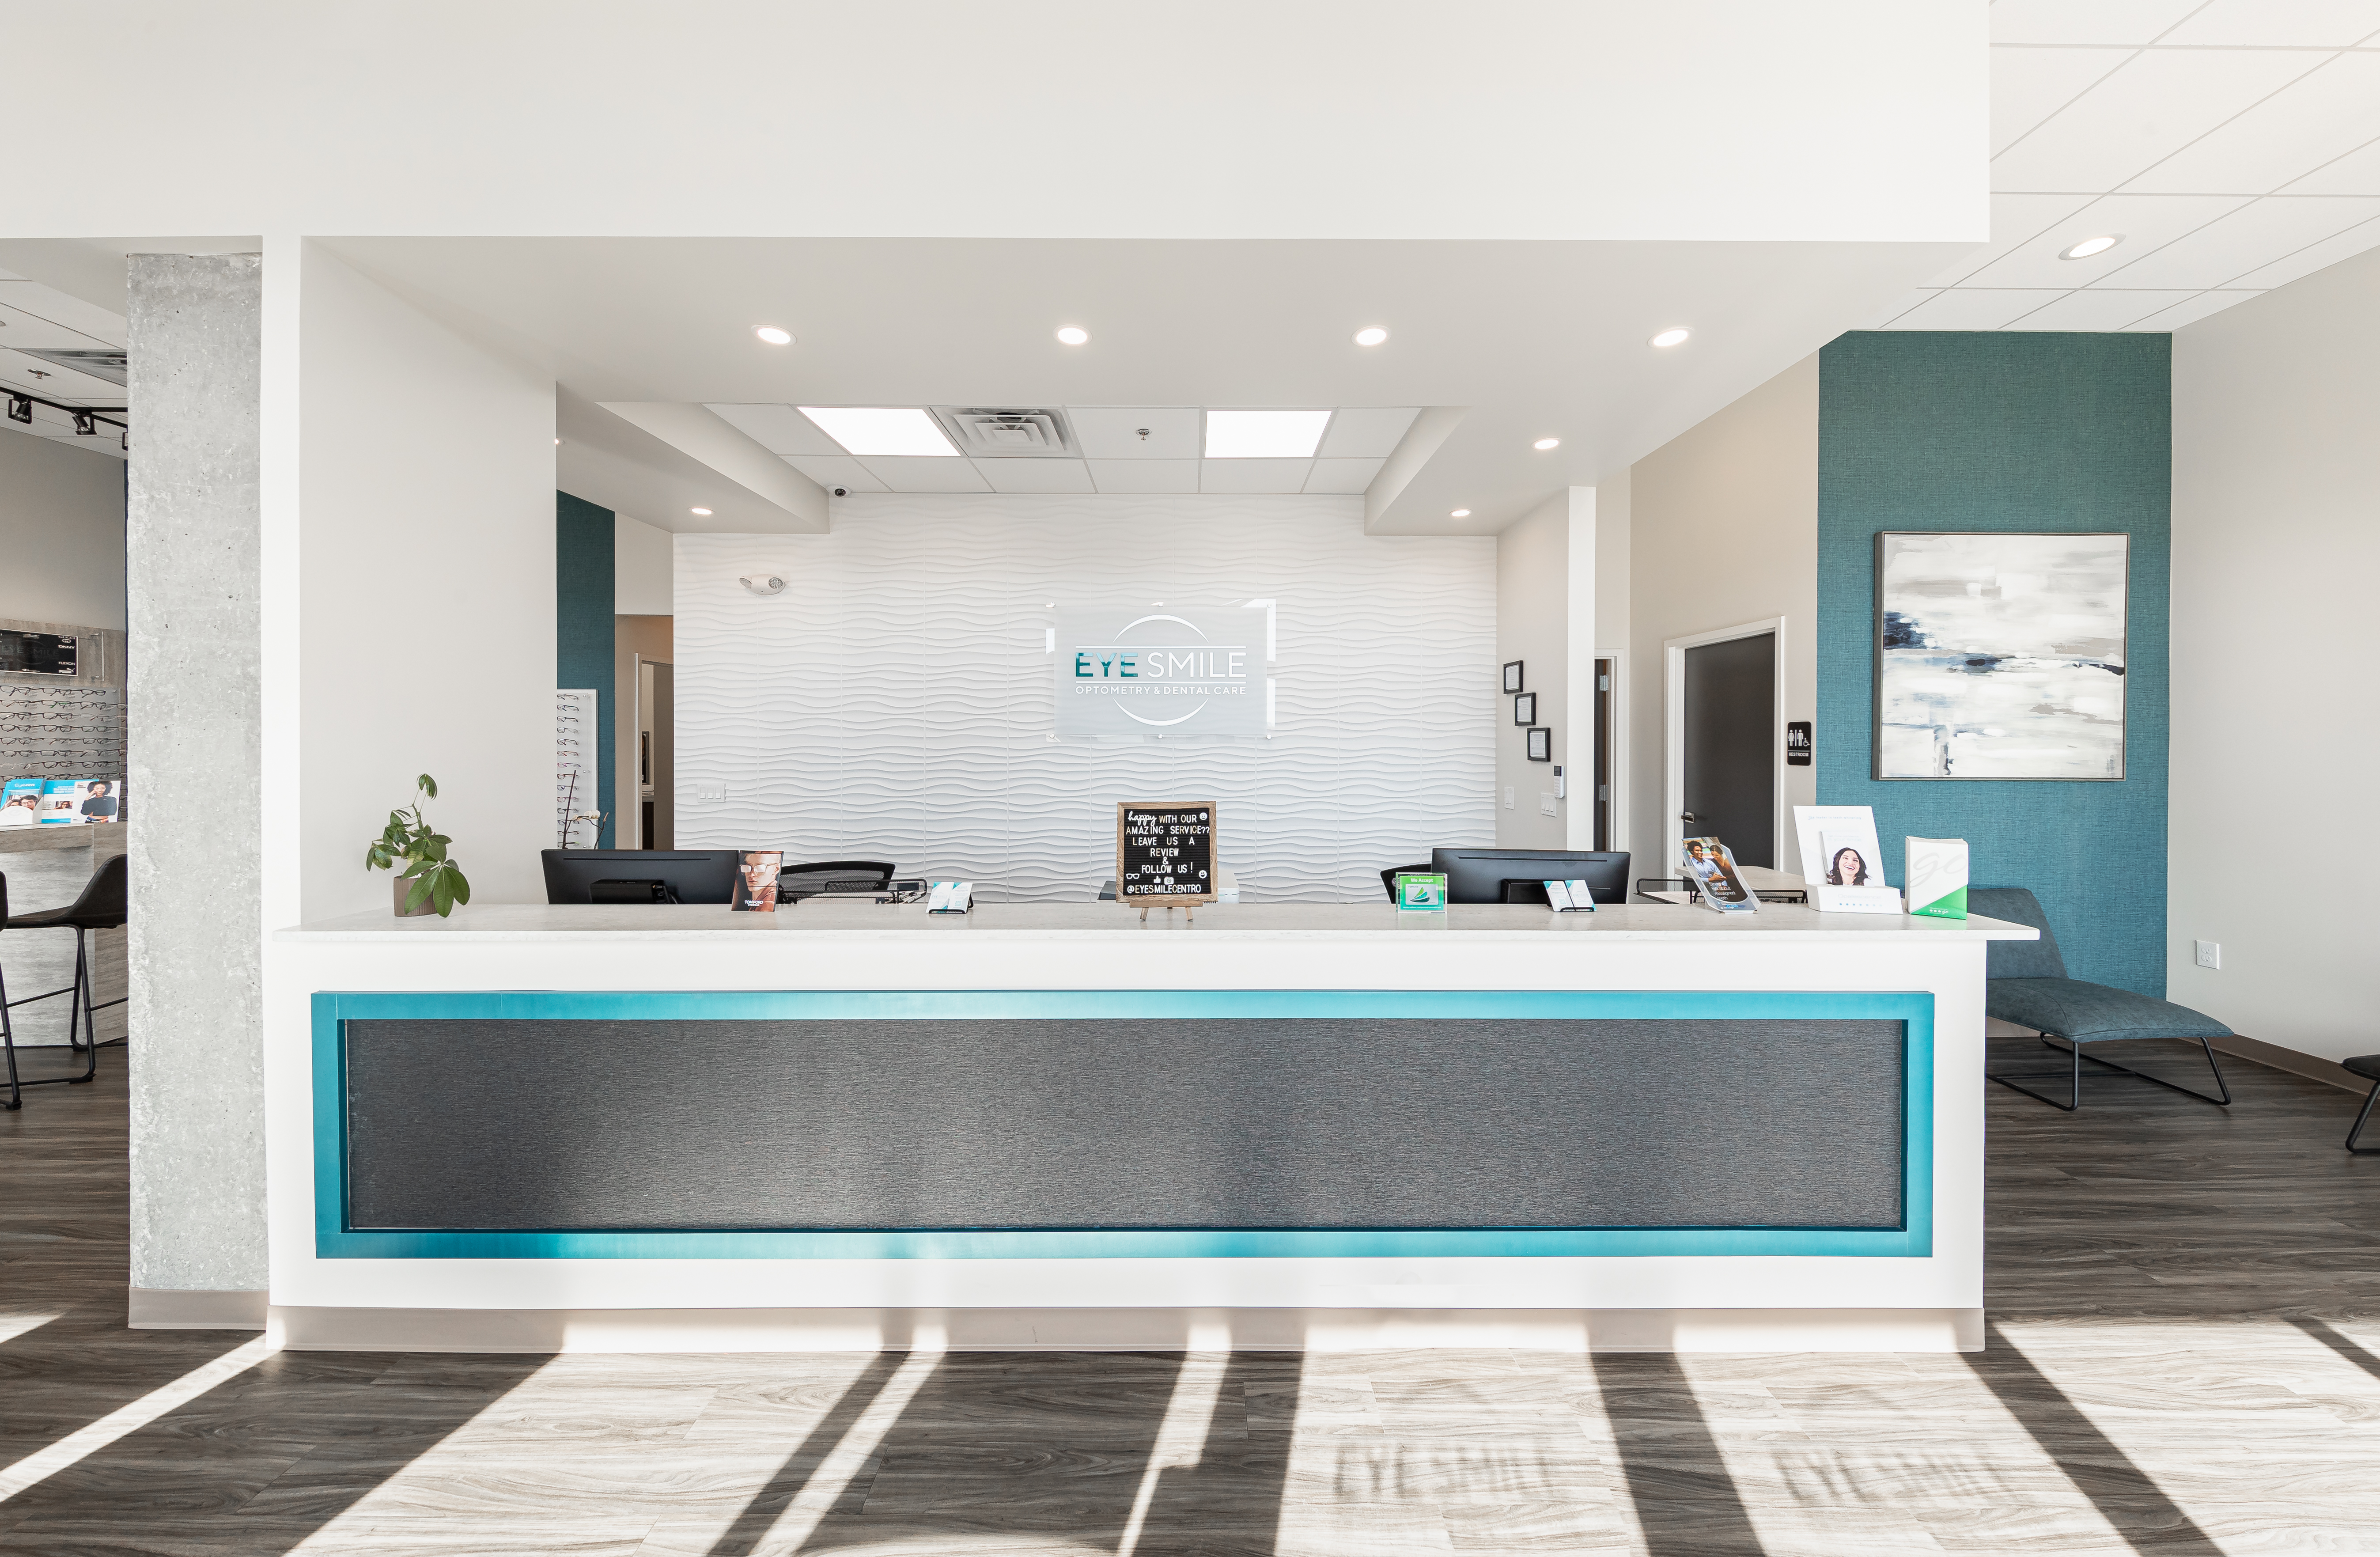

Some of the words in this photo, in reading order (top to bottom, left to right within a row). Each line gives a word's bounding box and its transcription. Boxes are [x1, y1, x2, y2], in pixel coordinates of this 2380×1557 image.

[1075, 652, 1139, 678] EYE
[1146, 652, 1247, 678] SMILE
[1075, 686, 1151, 695] OPTOMETRY
[1154, 686, 1161, 695] &
[1163, 686, 1211, 695] DENTAL
[1213, 686, 1246, 695] CARE
[1128, 811, 1157, 826] happy
[1159, 815, 1177, 823] WITH
[1126, 826, 1164, 835] AMAZING
[1170, 826, 1210, 834] SERVICE??
[1132, 837, 1157, 846] LEAVE
[1167, 837, 1178, 845] US
[1189, 837, 1195, 845] A
[1150, 848, 1179, 857] REVIEW
[1162, 856, 1169, 865] &
[1141, 865, 1172, 874] FOLLOW
[1127, 884, 1201, 894] @EYESMILECENTRO
